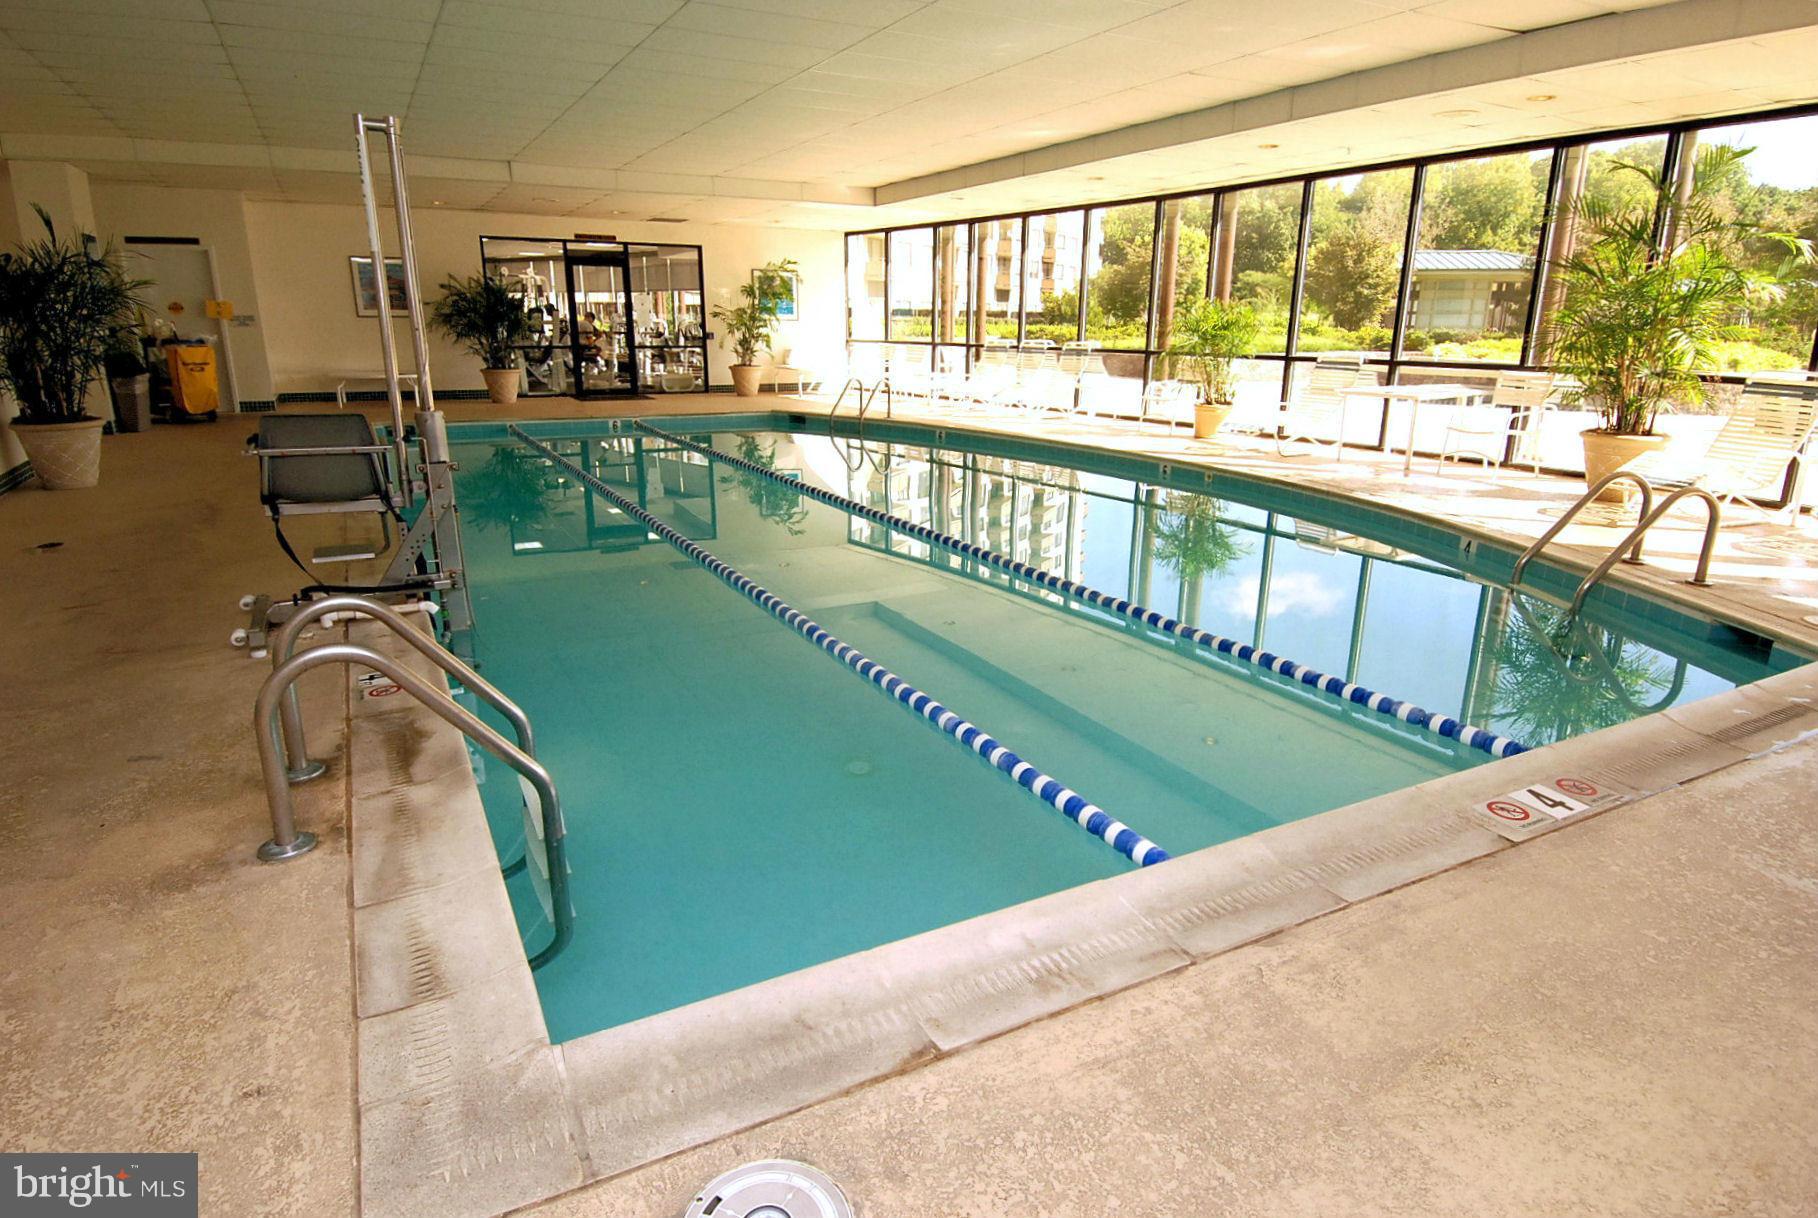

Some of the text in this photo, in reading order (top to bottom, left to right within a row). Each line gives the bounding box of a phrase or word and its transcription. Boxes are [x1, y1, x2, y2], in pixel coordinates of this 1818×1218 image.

[612, 420, 618, 433] 6
[1464, 540, 1472, 558] 4
[1525, 788, 1575, 811] 4
